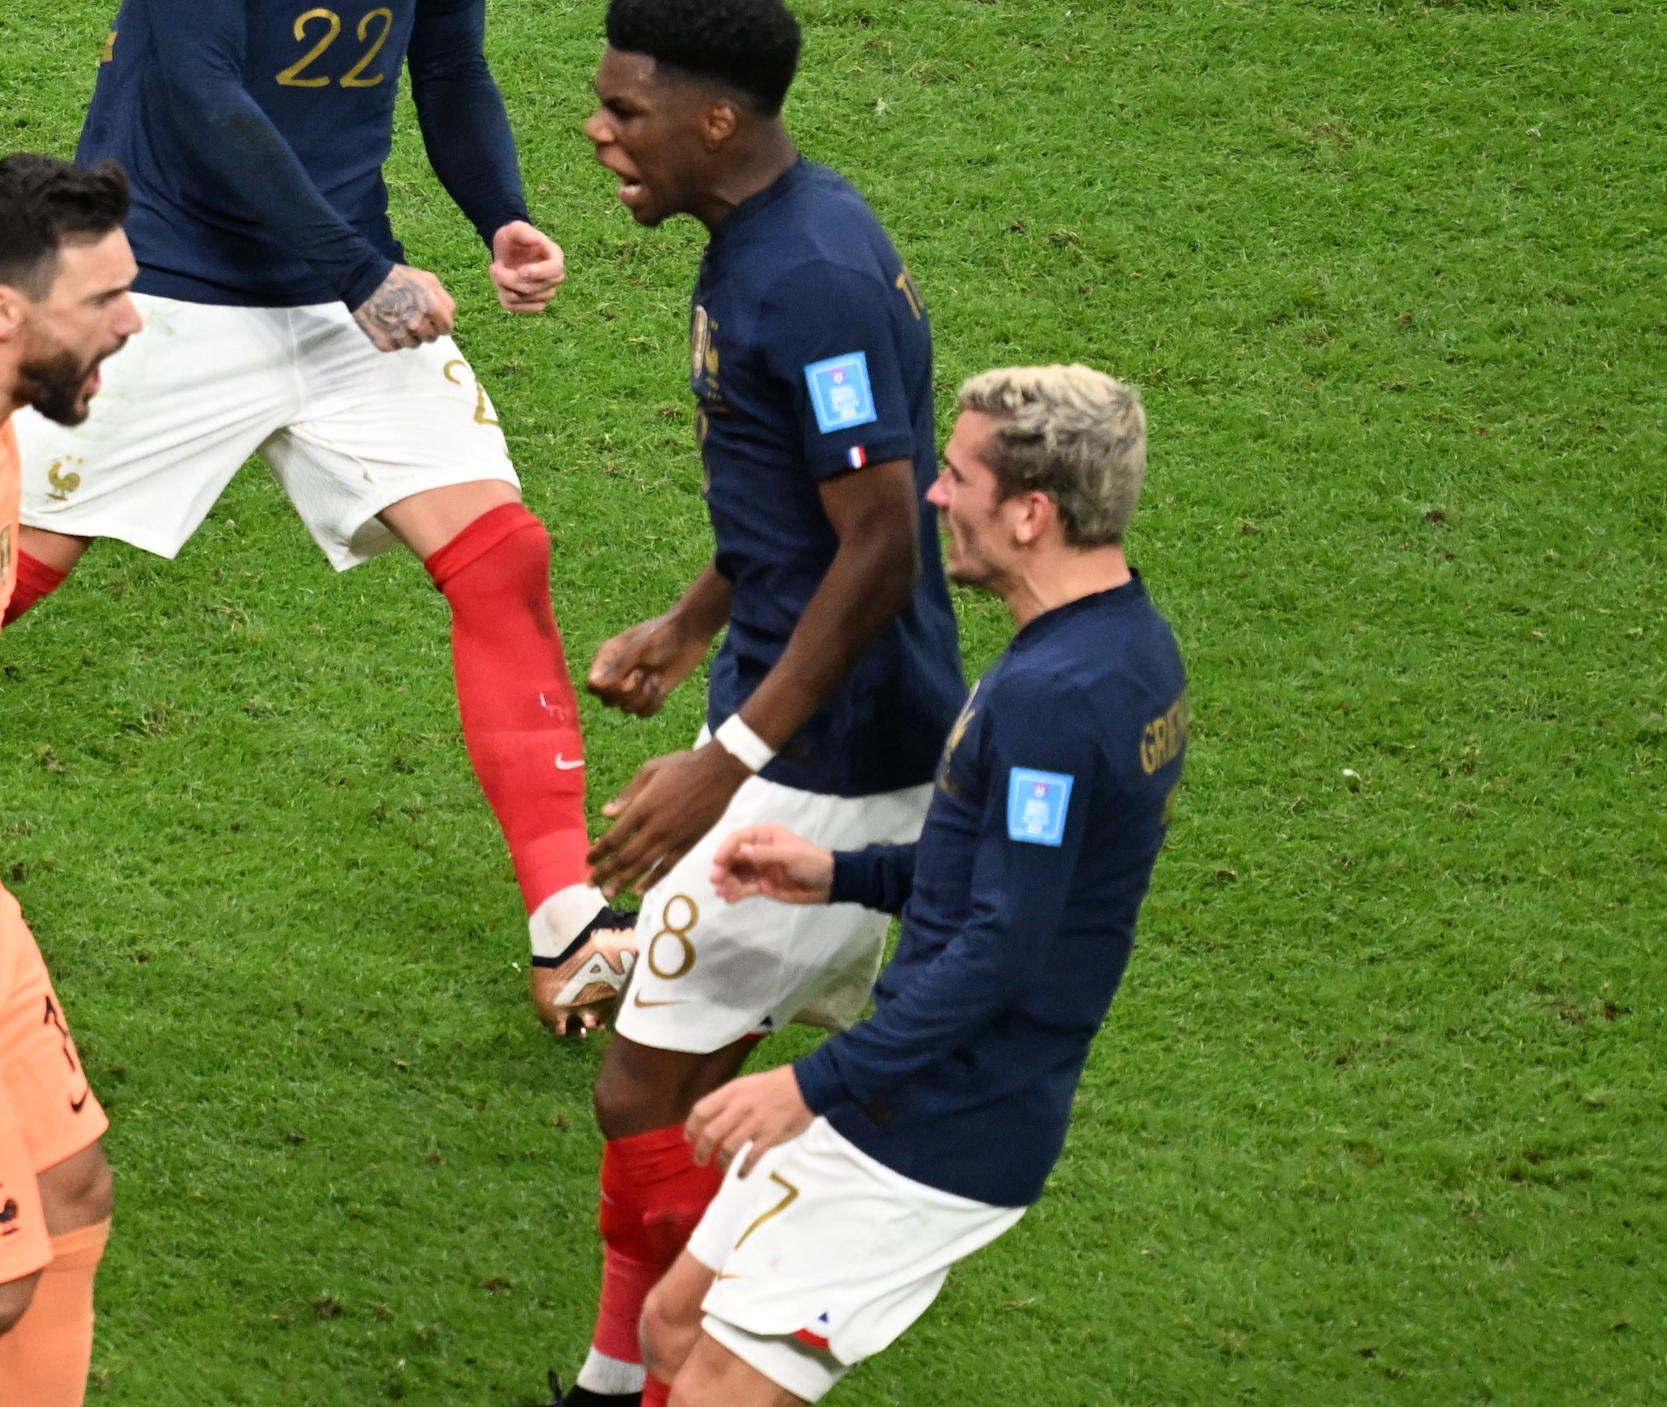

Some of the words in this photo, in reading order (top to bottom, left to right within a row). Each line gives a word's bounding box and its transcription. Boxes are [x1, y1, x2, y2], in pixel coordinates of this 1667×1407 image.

[275, 7, 393, 89] 22
[648, 893, 699, 980] 8
[734, 1171, 799, 1250] 7
